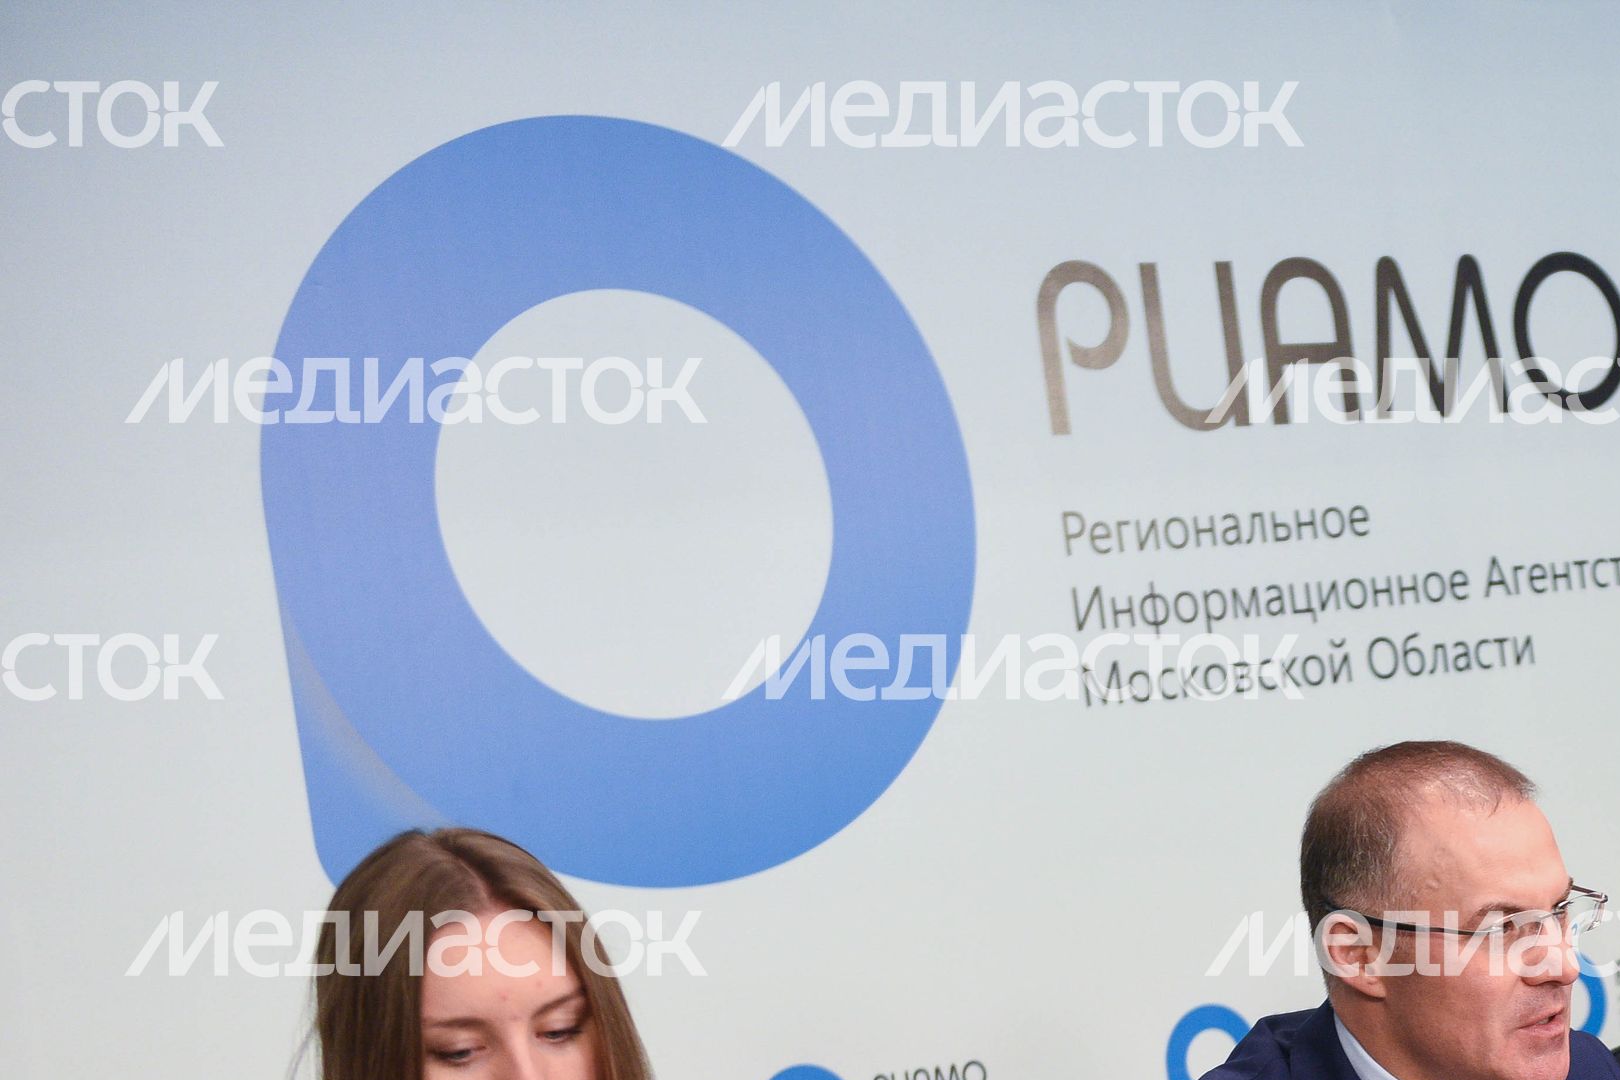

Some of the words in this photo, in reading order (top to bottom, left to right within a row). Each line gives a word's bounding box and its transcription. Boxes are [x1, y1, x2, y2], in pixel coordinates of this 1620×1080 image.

[1061, 504, 1370, 556] Региональное
[1072, 569, 1469, 634] Информационное
[1082, 638, 1352, 707] Московской
[1368, 632, 1536, 680] Области
